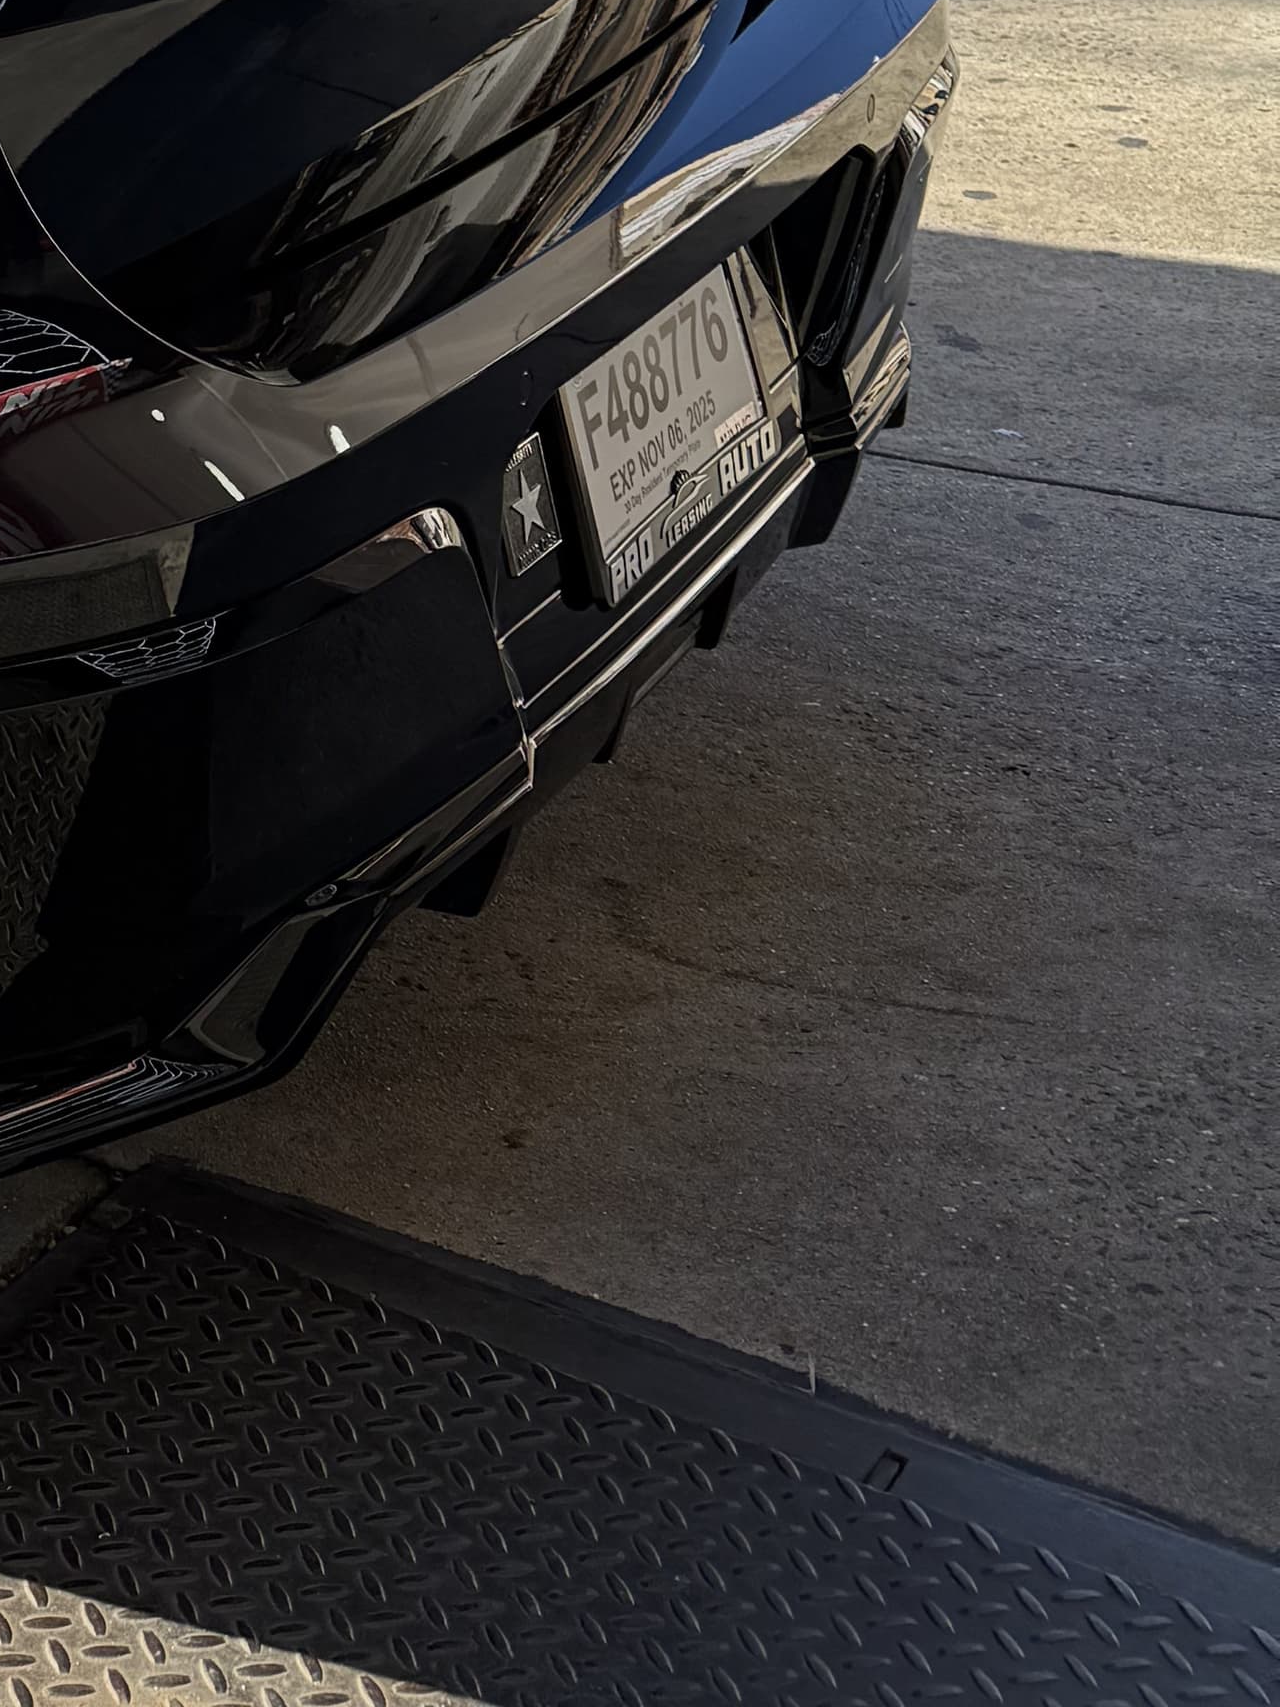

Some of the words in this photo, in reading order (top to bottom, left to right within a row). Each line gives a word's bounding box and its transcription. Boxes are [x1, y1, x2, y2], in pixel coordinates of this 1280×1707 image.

[576, 287, 729, 471] F488776
[610, 458, 636, 502] EXP
[638, 430, 666, 477] NOV
[686, 390, 717, 434] 2025
[610, 527, 654, 603] PRO
[667, 493, 714, 548] LEASING
[719, 420, 777, 496] AUTO
